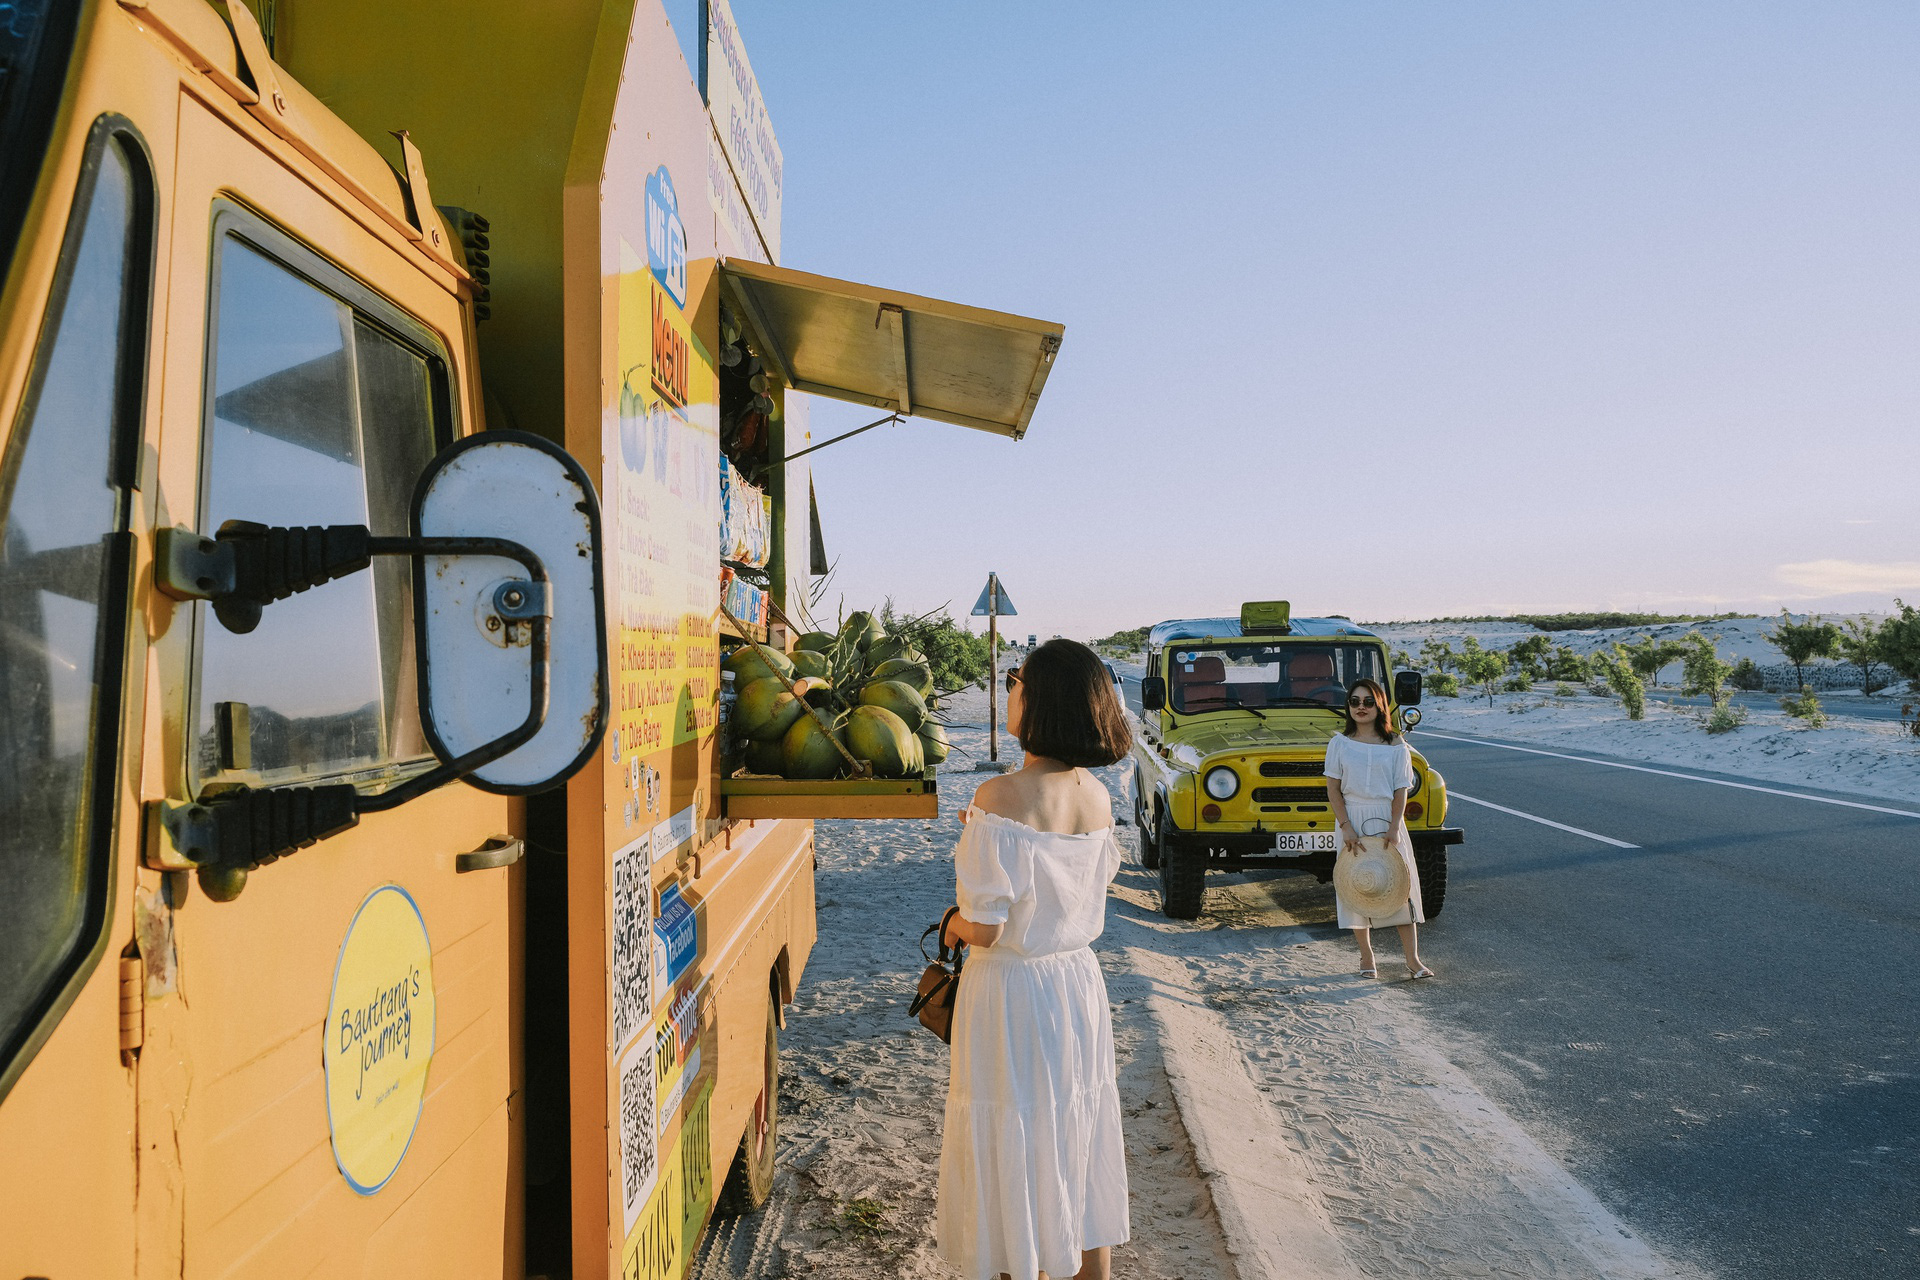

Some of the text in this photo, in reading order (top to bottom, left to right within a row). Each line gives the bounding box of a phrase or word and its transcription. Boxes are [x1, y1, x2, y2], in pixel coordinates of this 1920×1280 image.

[651, 281, 690, 407] Menu
[621, 642, 627, 672] 5.
[627, 643, 647, 671] Khoai
[647, 642, 659, 677] tây
[659, 643, 677, 670] chiên:
[621, 682, 627, 712] 6.
[637, 681, 646, 715] Ly
[646, 680, 659, 708] Xúc
[621, 722, 628, 752] 7.
[628, 719, 642, 750] Dừa
[643, 717, 662, 750] Rạng:
[654, 901, 687, 932] FOLLOW US ON
[667, 916, 694, 965] facebook
[340, 964, 420, 1056] Bautrang's
